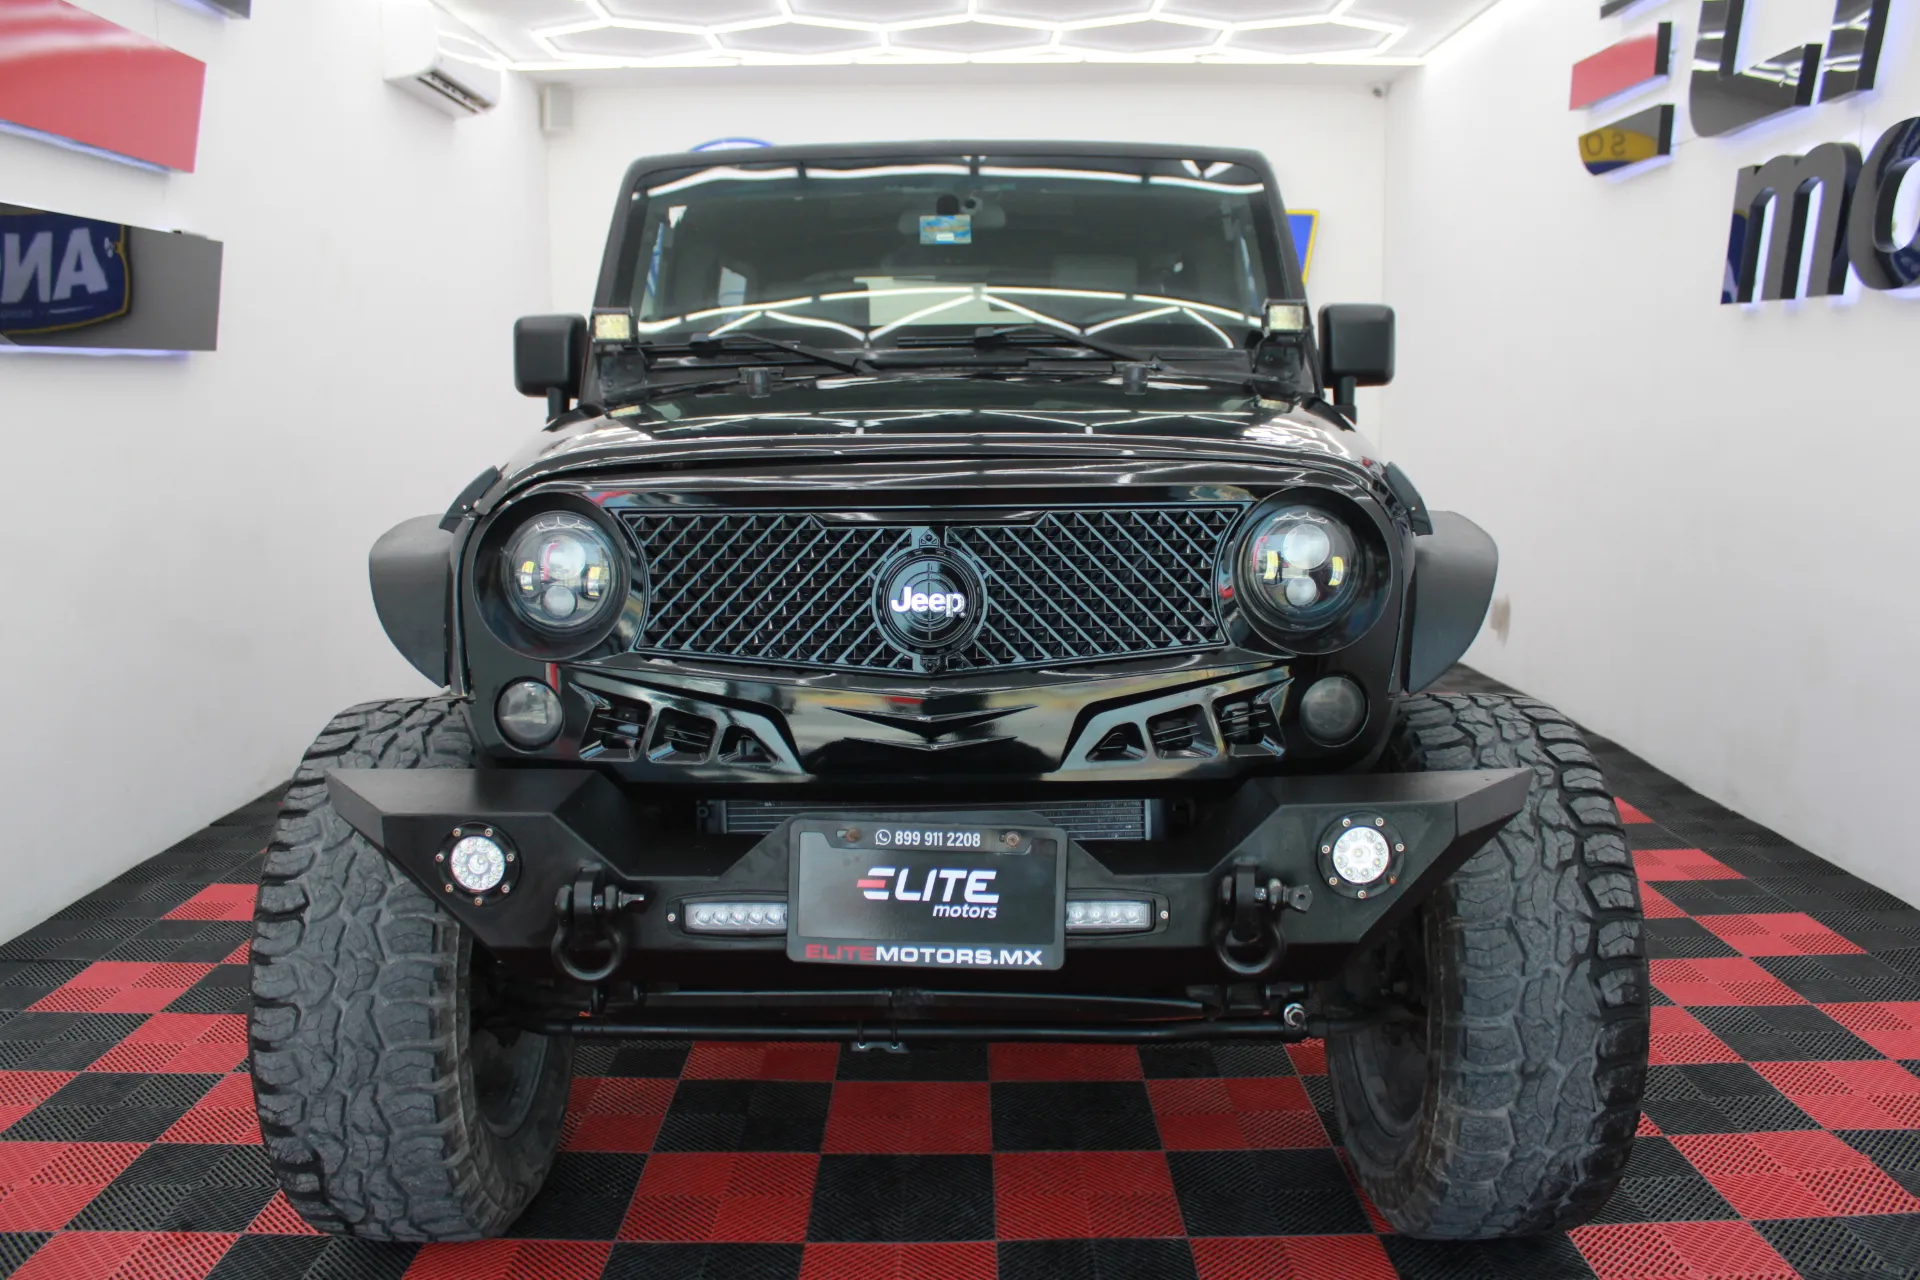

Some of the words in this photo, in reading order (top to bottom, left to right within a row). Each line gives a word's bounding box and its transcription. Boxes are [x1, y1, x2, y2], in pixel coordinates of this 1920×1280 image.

[890, 586, 964, 617] Jeep
[895, 831, 920, 845] 899
[924, 832, 942, 846] 911
[947, 832, 981, 847] 2208
[857, 867, 999, 904] ELITE
[933, 904, 997, 919] motors
[805, 944, 1043, 966] ELITEMOTORS.MX
